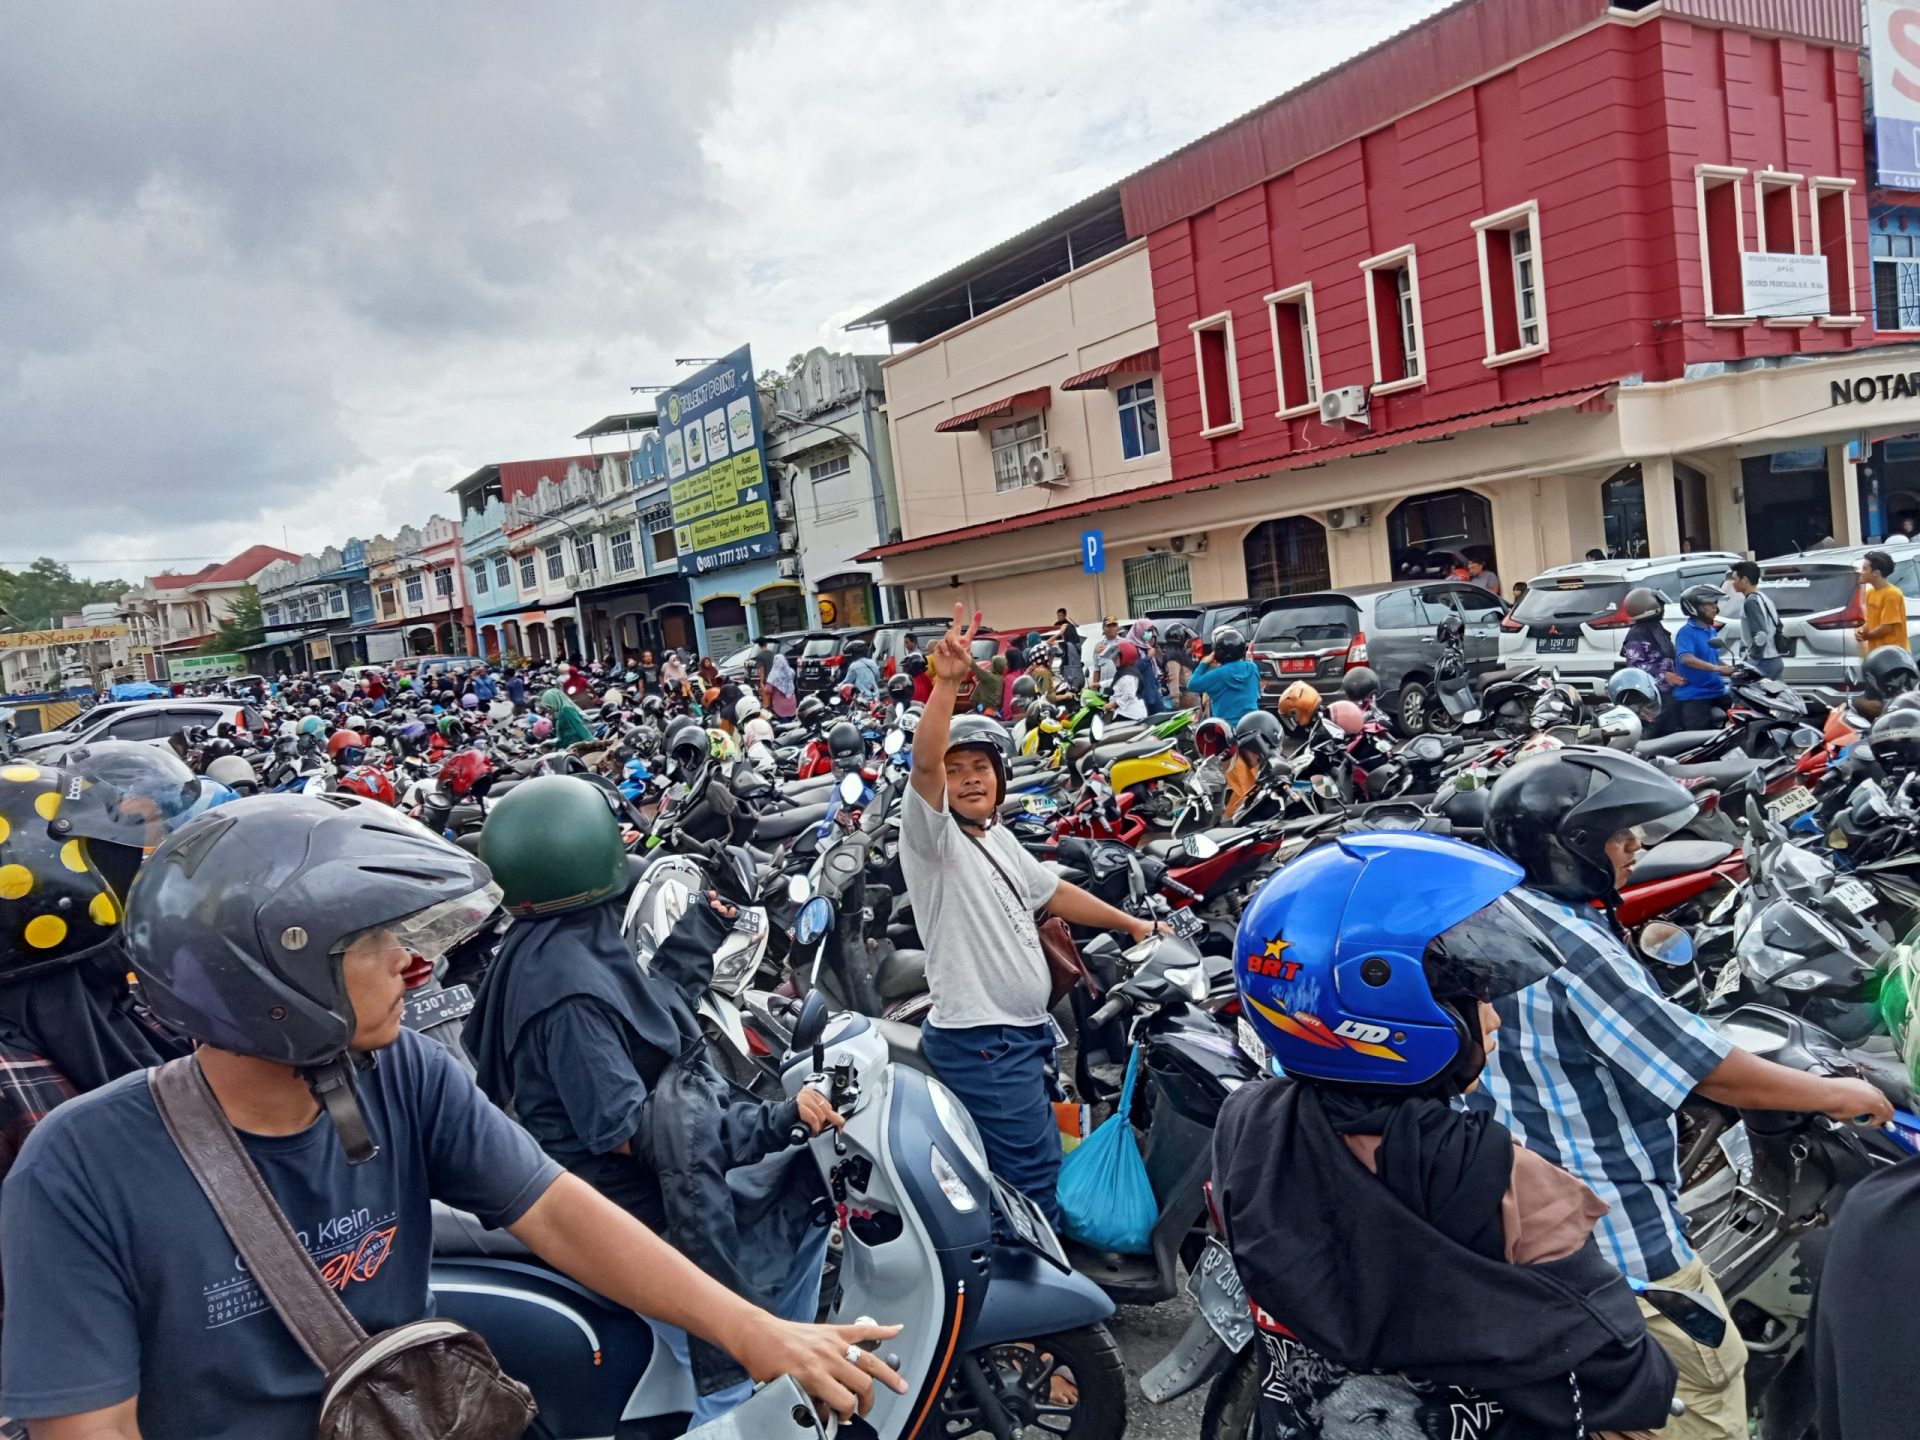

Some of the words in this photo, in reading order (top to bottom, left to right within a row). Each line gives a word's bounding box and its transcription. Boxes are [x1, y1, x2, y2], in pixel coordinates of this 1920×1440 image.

[680, 383, 708, 414] TALENT
[708, 369, 735, 400] POINT
[745, 507, 764, 518] Dewasa
[743, 521, 765, 534] Parenting
[703, 554, 718, 568] 0811
[720, 550, 735, 565] 7777
[735, 546, 749, 560] 313
[1087, 536, 1097, 567] P
[1248, 954, 1303, 981] BRT
[414, 992, 447, 1014] 2307
[1333, 1020, 1391, 1043] LTD
[318, 1207, 371, 1243] Klein
[1203, 1247, 1222, 1270] BP
[207, 1290, 260, 1313] QUALITY
